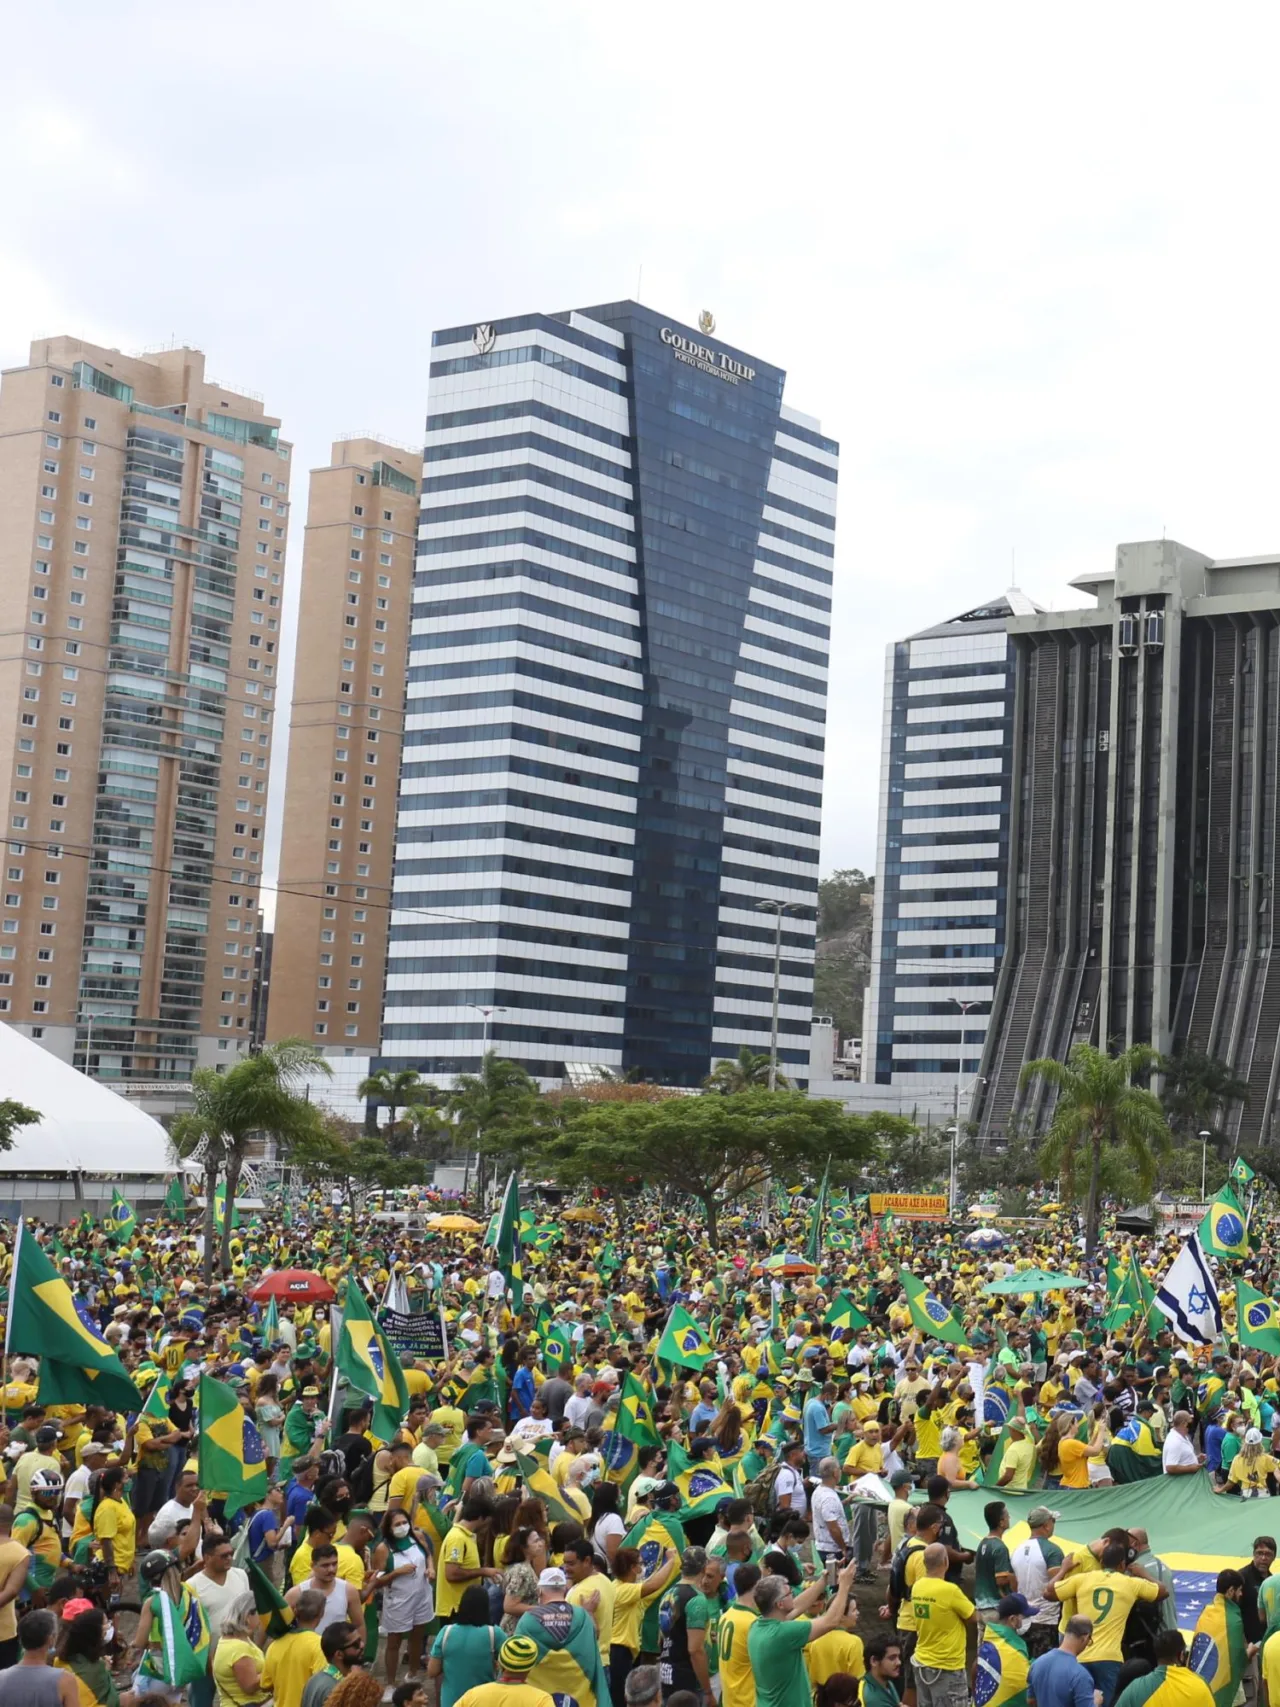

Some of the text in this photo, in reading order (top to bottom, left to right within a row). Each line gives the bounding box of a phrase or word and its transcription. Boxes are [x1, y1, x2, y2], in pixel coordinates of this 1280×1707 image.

[660, 327, 756, 380] GOLDEN TULIP
[720, 370, 739, 385] HOTEL
[929, 1199, 946, 1209] BAHIA
[290, 1281, 309, 1291] AÇAÍ
[167, 1349, 179, 1367] 10
[1092, 1587, 1114, 1625] 9
